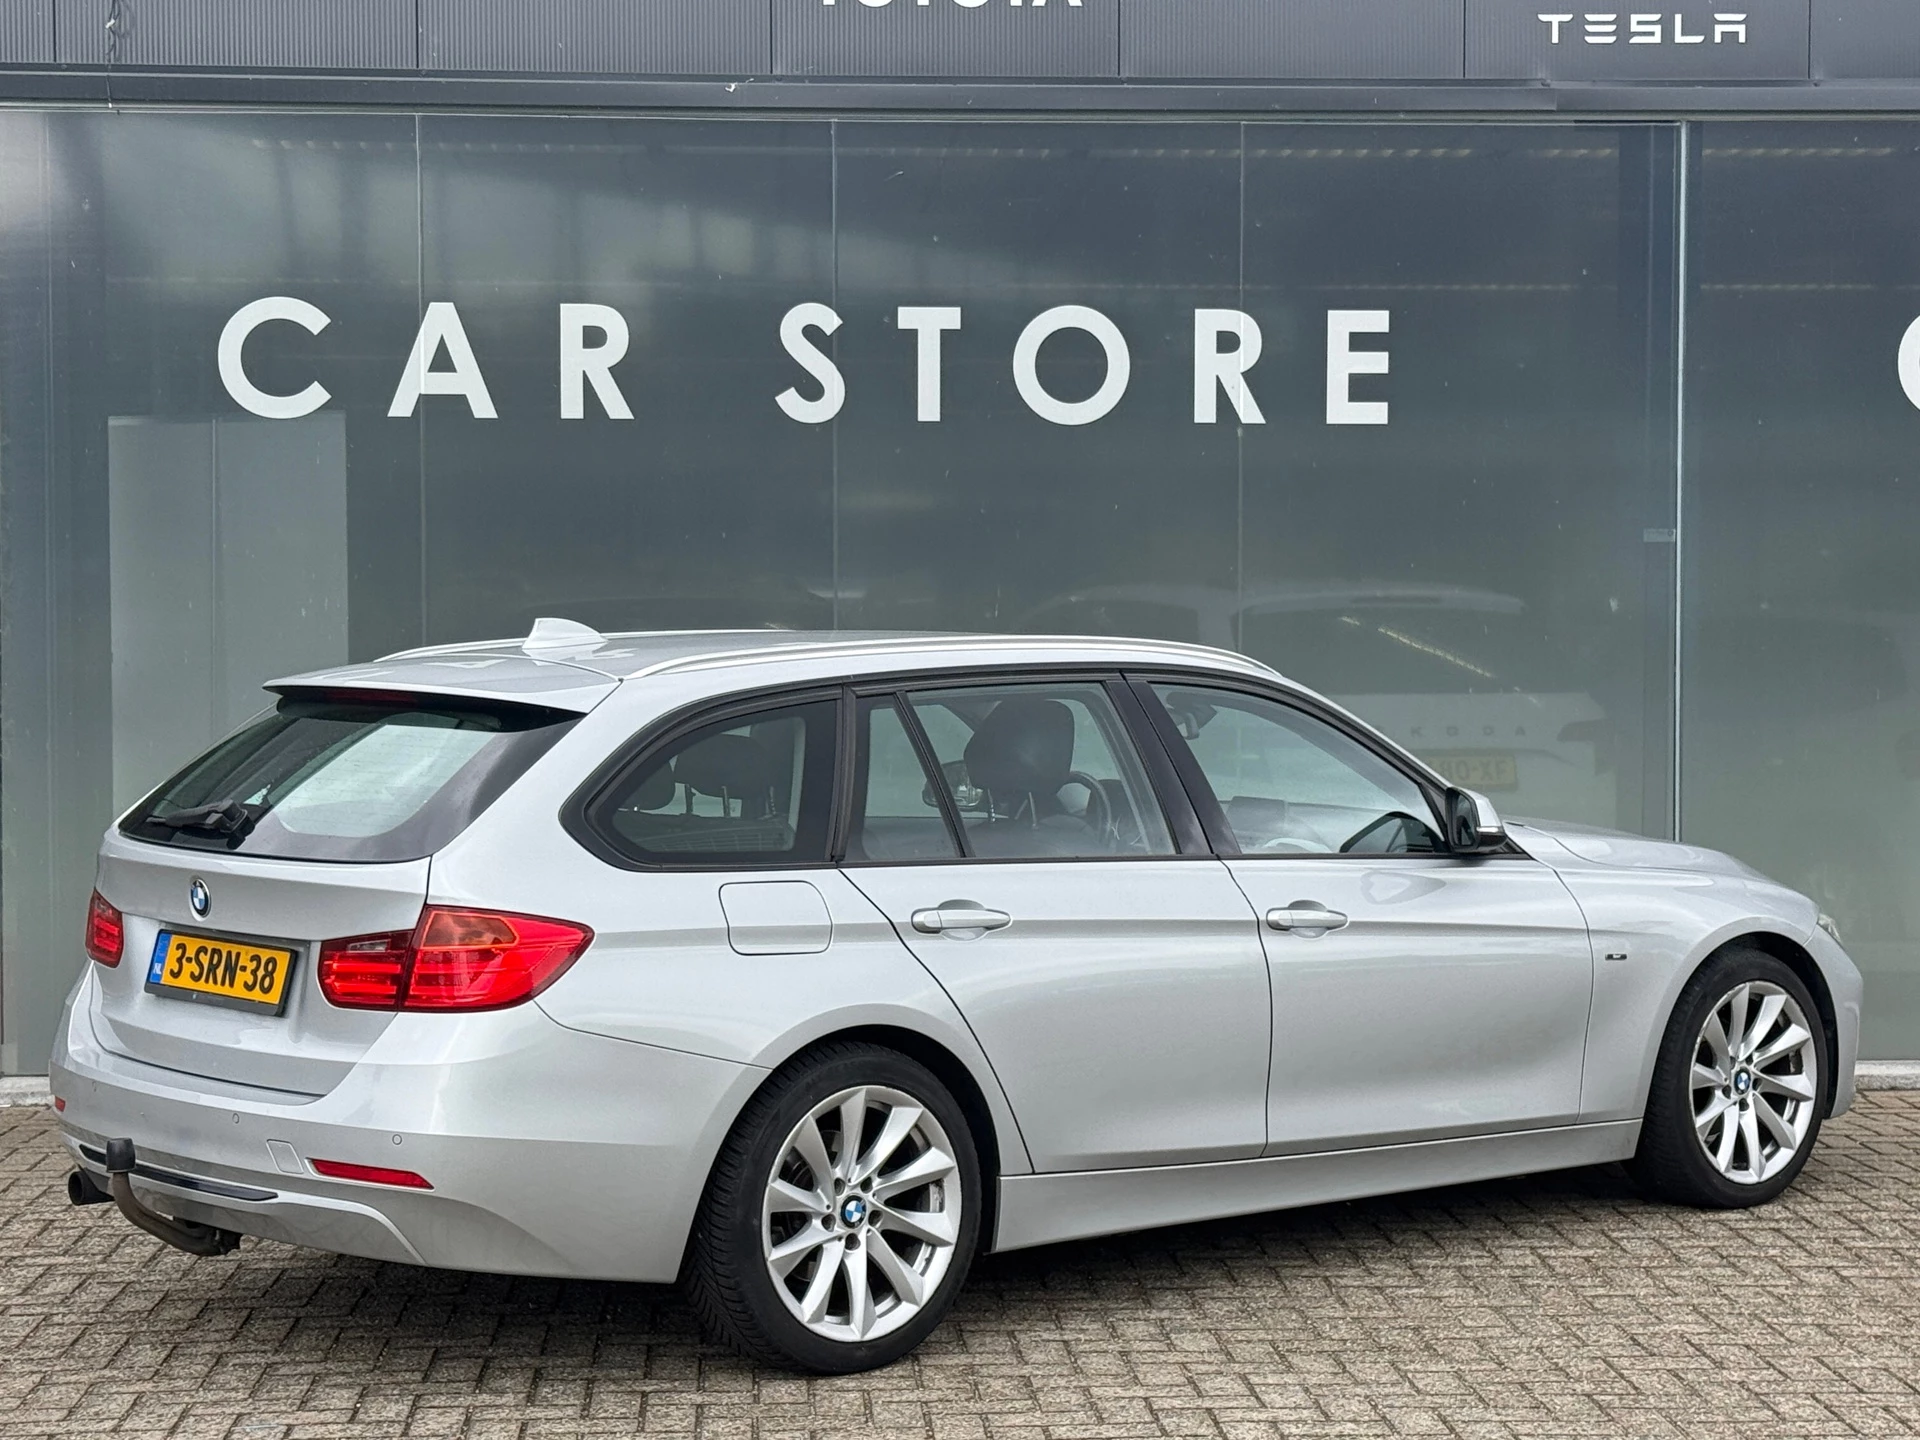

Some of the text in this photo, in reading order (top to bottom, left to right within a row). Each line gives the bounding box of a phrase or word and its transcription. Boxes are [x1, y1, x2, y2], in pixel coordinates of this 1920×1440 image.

[1537, 13, 1747, 44] TESLA
[217, 296, 1391, 426] CAR STORE
[169, 942, 278, 995] 3-SRN-38
